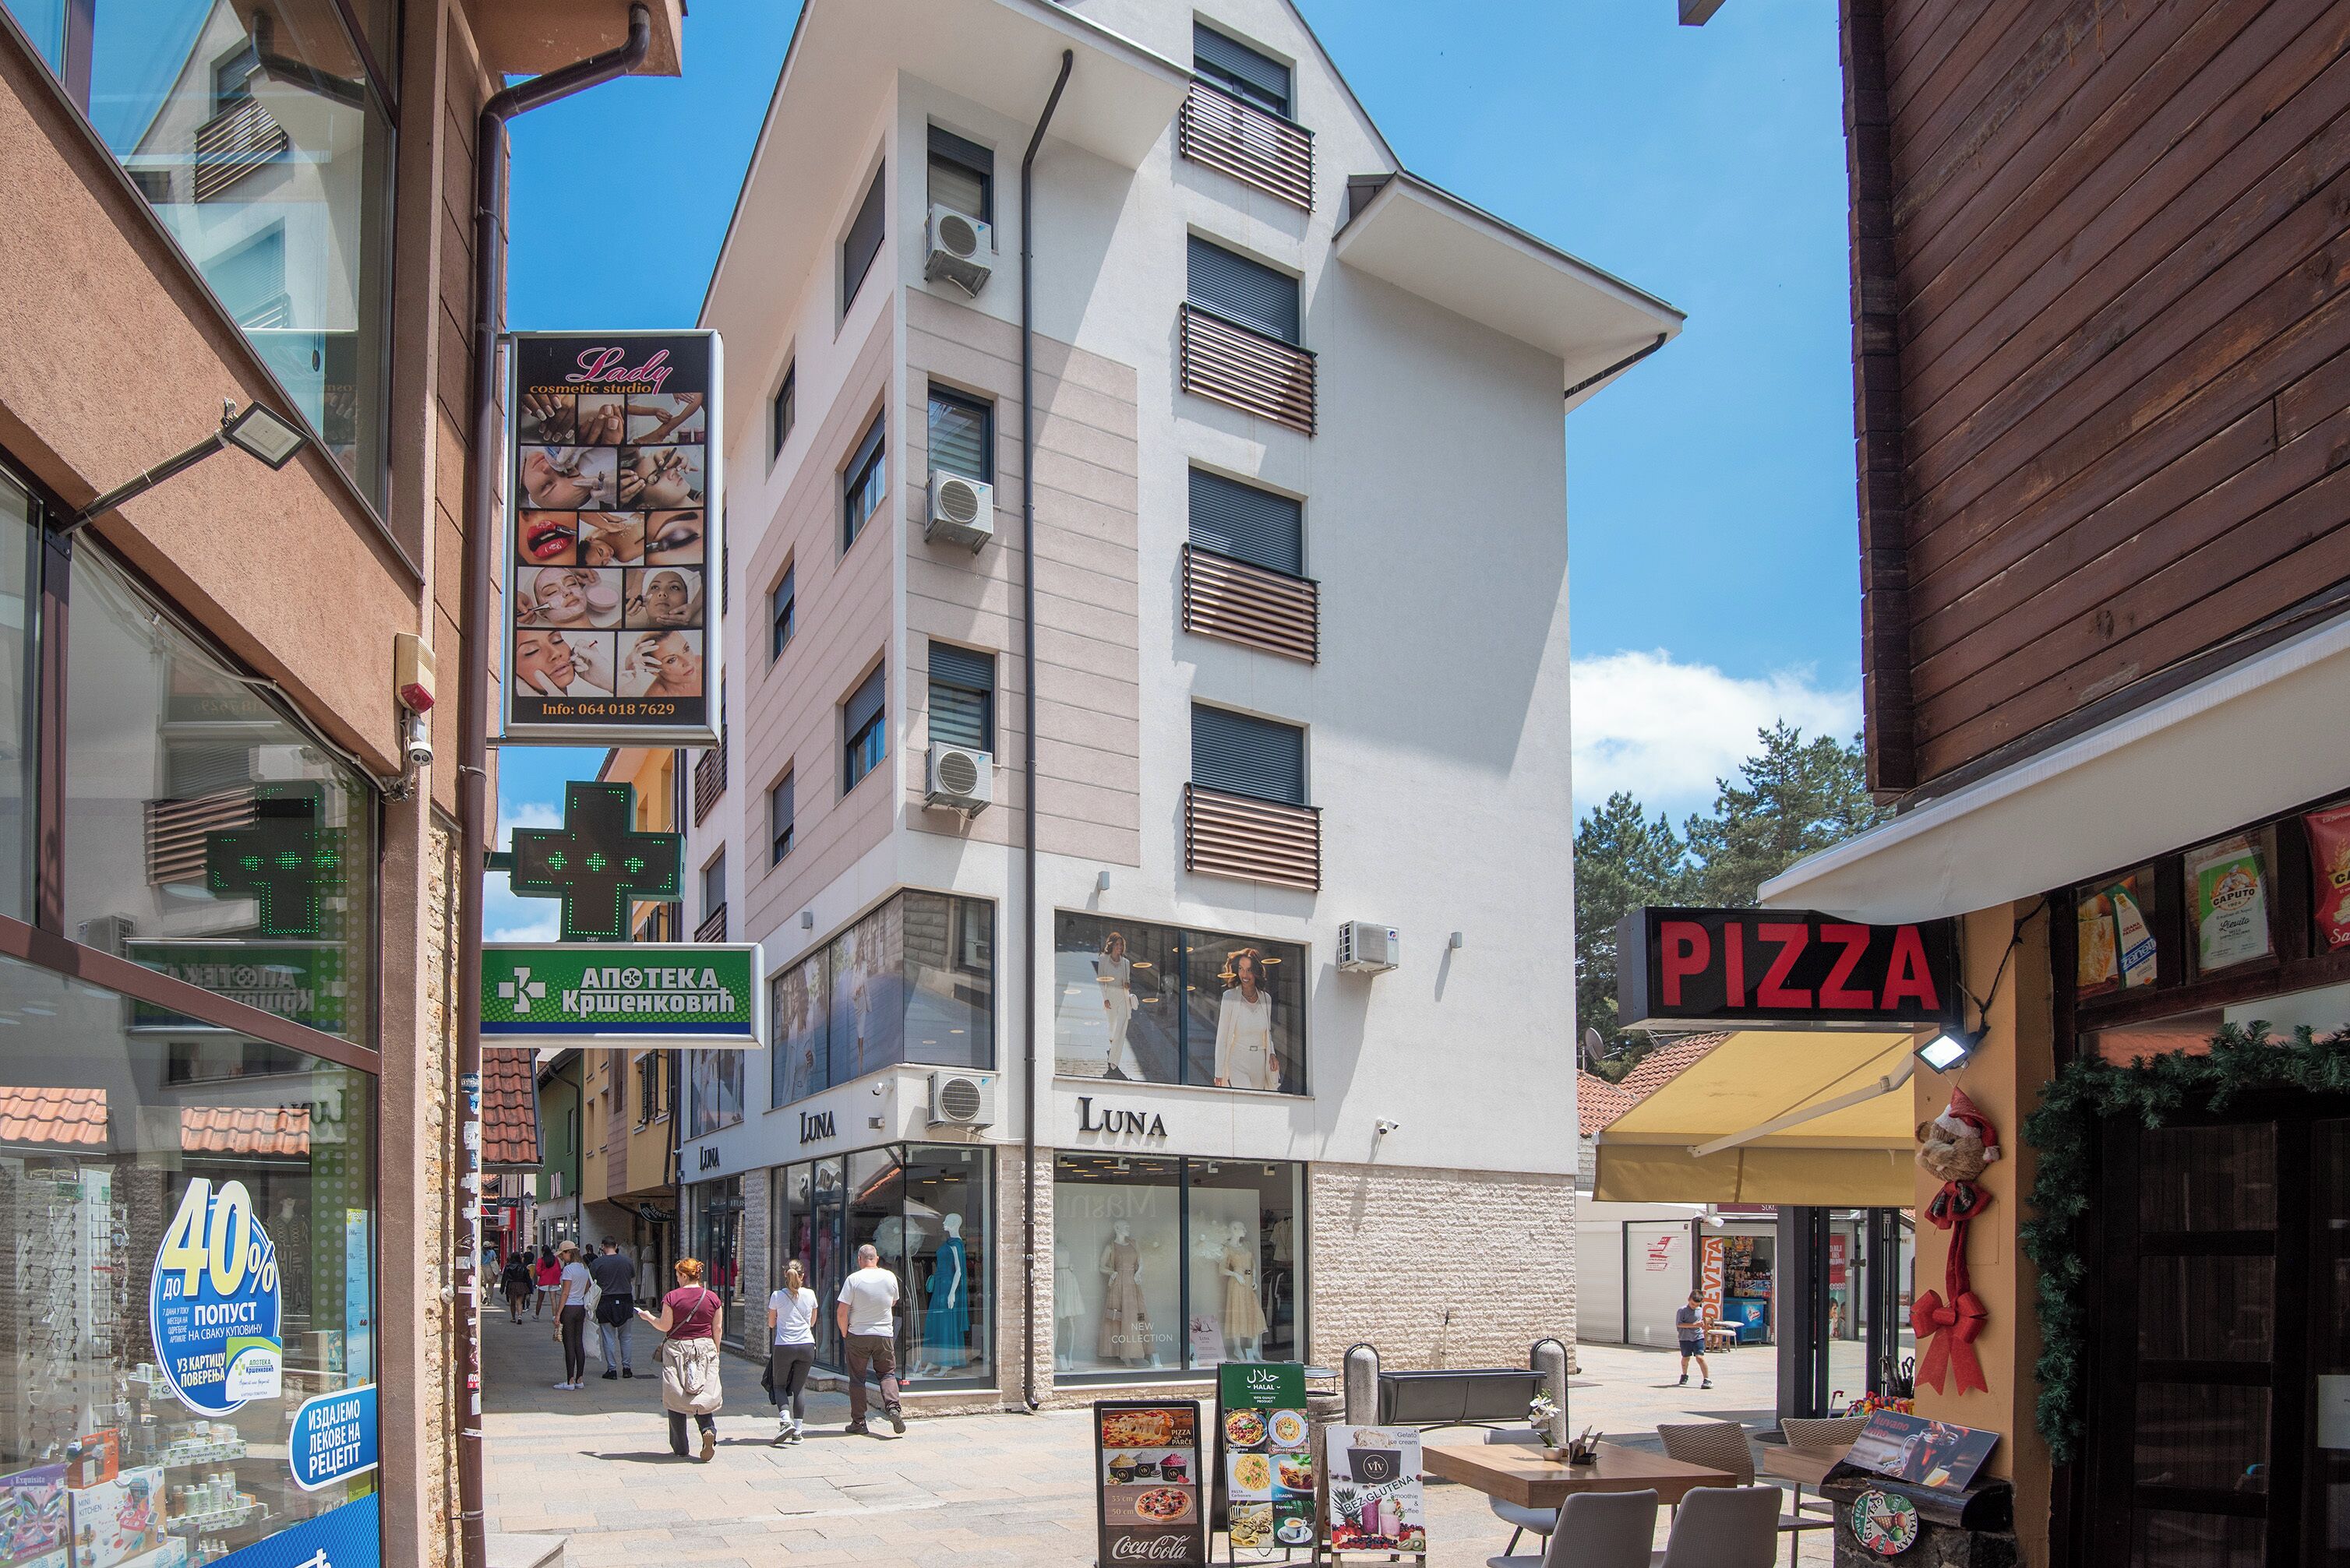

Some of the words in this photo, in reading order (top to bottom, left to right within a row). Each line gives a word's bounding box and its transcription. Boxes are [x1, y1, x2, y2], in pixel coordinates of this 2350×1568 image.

[566, 347, 673, 395] Lady
[530, 383, 598, 394] cosmetic
[603, 382, 652, 394] studio
[542, 703, 575, 715] Info:
[578, 703, 605, 715] 064
[609, 703, 635, 715] 018
[640, 703, 676, 715] 7629
[2213, 888, 2255, 906] CAPUTO
[1660, 921, 1941, 1011] PIZZA
[580, 967, 719, 988] АПОТЕКА
[562, 988, 735, 1018] Кршенковић
[1078, 1097, 1168, 1136] LUNA
[799, 1111, 836, 1144] LUNA
[161, 1177, 276, 1296] 40%
[1702, 1237, 1724, 1321] DEVITA
[194, 1302, 257, 1327] ПОПУСТ
[188, 1330, 200, 1341] НА
[200, 1327, 224, 1340] СВАКУ
[225, 1323, 263, 1337] КУПОВИНУ
[1131, 1322, 1154, 1331] NEW
[1111, 1334, 1173, 1344] COLLECTION
[176, 1358, 188, 1373] УЗ
[189, 1352, 226, 1370] КАРТИЦУ
[181, 1369, 225, 1388] ПОВЕРЕЊА
[1247, 1369, 1279, 1383] حلال
[308, 1399, 361, 1432] ИЗДАЈЕМО
[1873, 1415, 1910, 1431] kuvano
[309, 1425, 347, 1455] ЛЕКОВЕ
[348, 1422, 361, 1443] НА
[1868, 1426, 1889, 1438] vino
[309, 1442, 361, 1478] РЕЦЕПТ
[15, 1476, 45, 1485] Exquisite
[78, 1498, 91, 1507] MINI
[1343, 1497, 1366, 1513] BEZ
[1366, 1475, 1415, 1503] GLUTENA
[79, 1503, 102, 1516] KITCHEN
